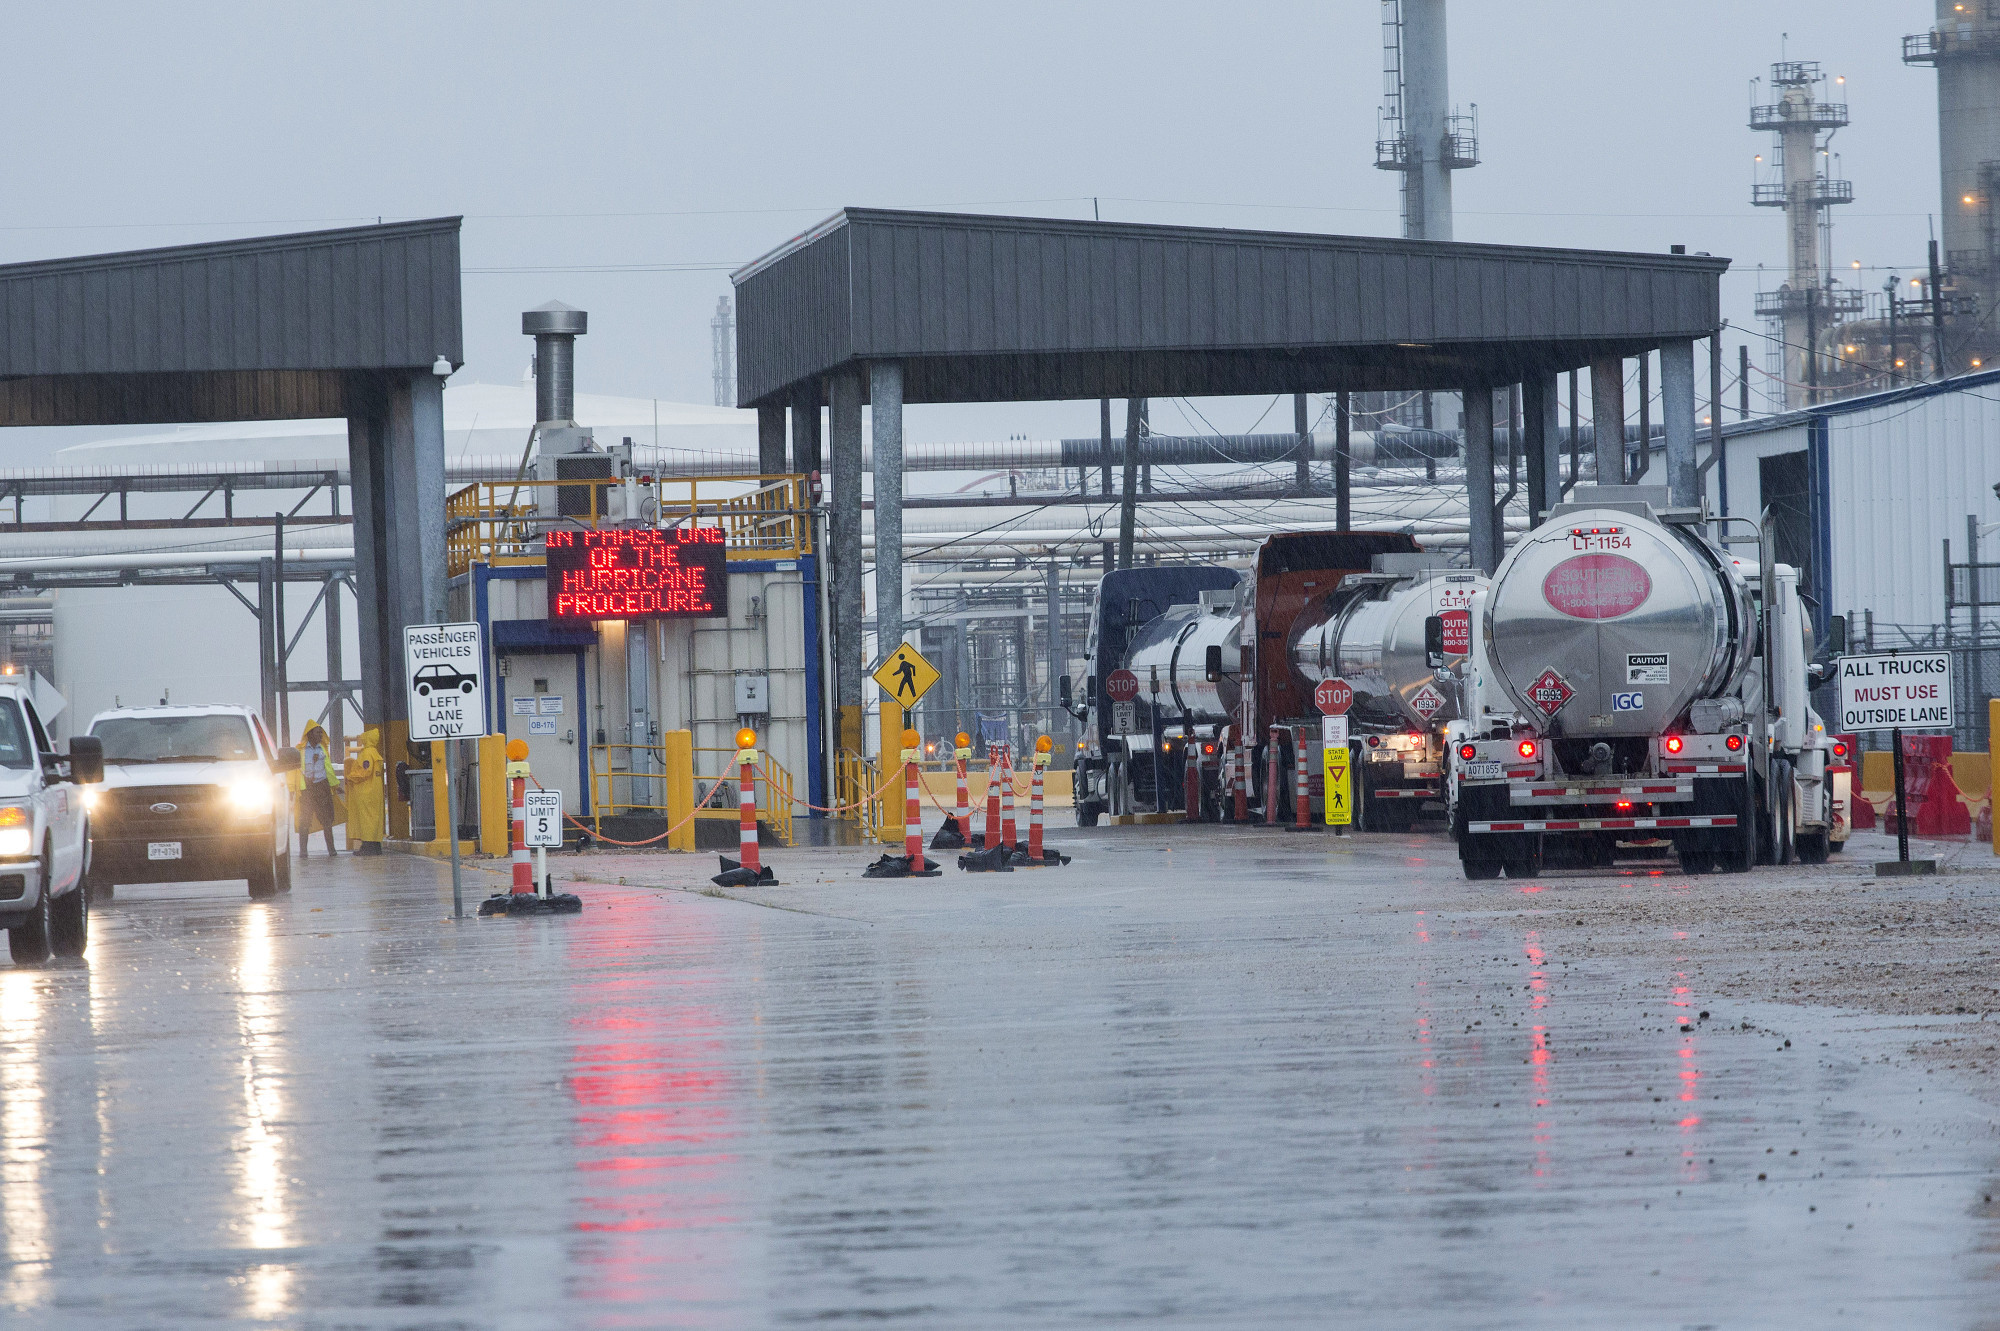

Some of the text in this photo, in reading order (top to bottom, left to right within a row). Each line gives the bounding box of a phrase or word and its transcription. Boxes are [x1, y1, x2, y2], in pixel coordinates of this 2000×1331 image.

[546, 531, 573, 547] IN
[584, 529, 665, 546] PHASE
[1573, 536, 1632, 551] LT-1154
[590, 545, 680, 568] OF THE
[562, 566, 706, 591] HURRICANE
[1560, 567, 1632, 582] SOUTHERN
[1550, 581, 1645, 597] TANK LEASING
[557, 589, 713, 615] PROCEDURE.
[1443, 619, 1468, 628] OUTH
[409, 631, 477, 645] PASSENGER
[413, 645, 471, 659] VEHICLES
[1631, 656, 1665, 665] CAUTION
[1844, 658, 1946, 678] ALL TRUCKS
[1108, 679, 1137, 692] STOP
[1317, 689, 1351, 705] STOP
[1536, 689, 1562, 700] 1993
[1854, 684, 1938, 702] MUST USE
[430, 696, 461, 707] LEFT
[1418, 700, 1435, 709] 1993
[1612, 693, 1643, 711] IGC
[428, 709, 463, 721] LANE
[1120, 717, 1128, 727] 5
[1846, 706, 1948, 725] OUTSIDE LANE
[430, 723, 464, 735] ONLY
[531, 721, 555, 729] OB-176
[1468, 764, 1500, 775] A071855
[528, 796, 558, 806] SPEED
[531, 807, 555, 816] LIMIT
[538, 818, 548, 833] 5
[534, 834, 553, 842] MPH
